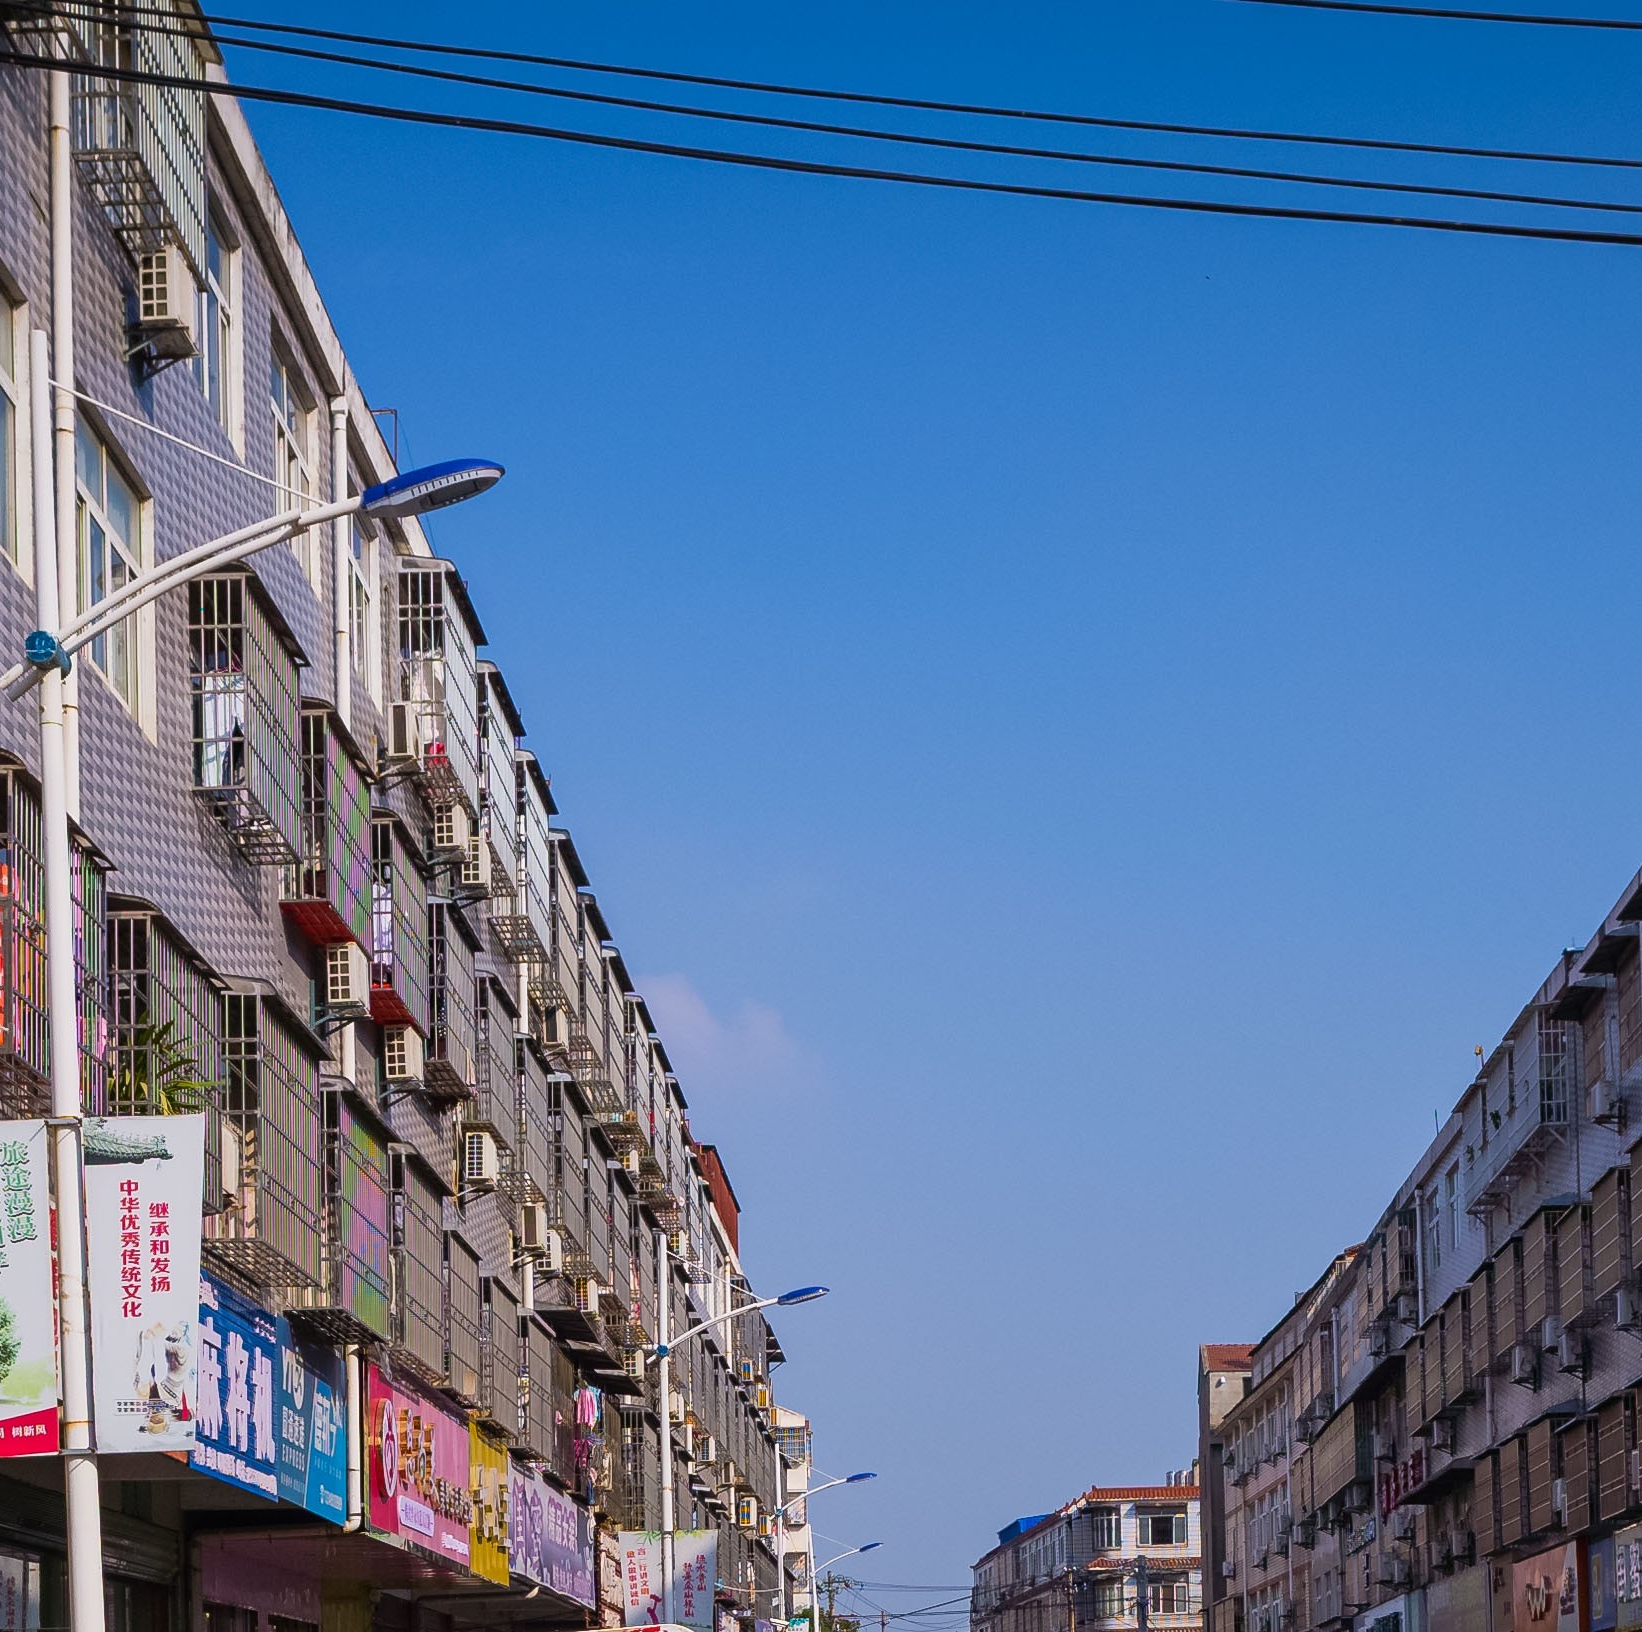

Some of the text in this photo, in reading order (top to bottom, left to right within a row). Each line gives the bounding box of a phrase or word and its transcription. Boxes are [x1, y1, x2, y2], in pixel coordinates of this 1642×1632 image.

[119, 1179, 142, 1318] 中华优秀传统文化
[149, 1202, 170, 1293] 继承和发扬
[11, 1424, 47, 1438] 树新风
[282, 1443, 305, 1473] EXPRESS
[626, 1550, 639, 1606] 做人做事讲诚信
[637, 1542, 649, 1595] 一言一行讲文明
[696, 1554, 708, 1591] 绿水青山
